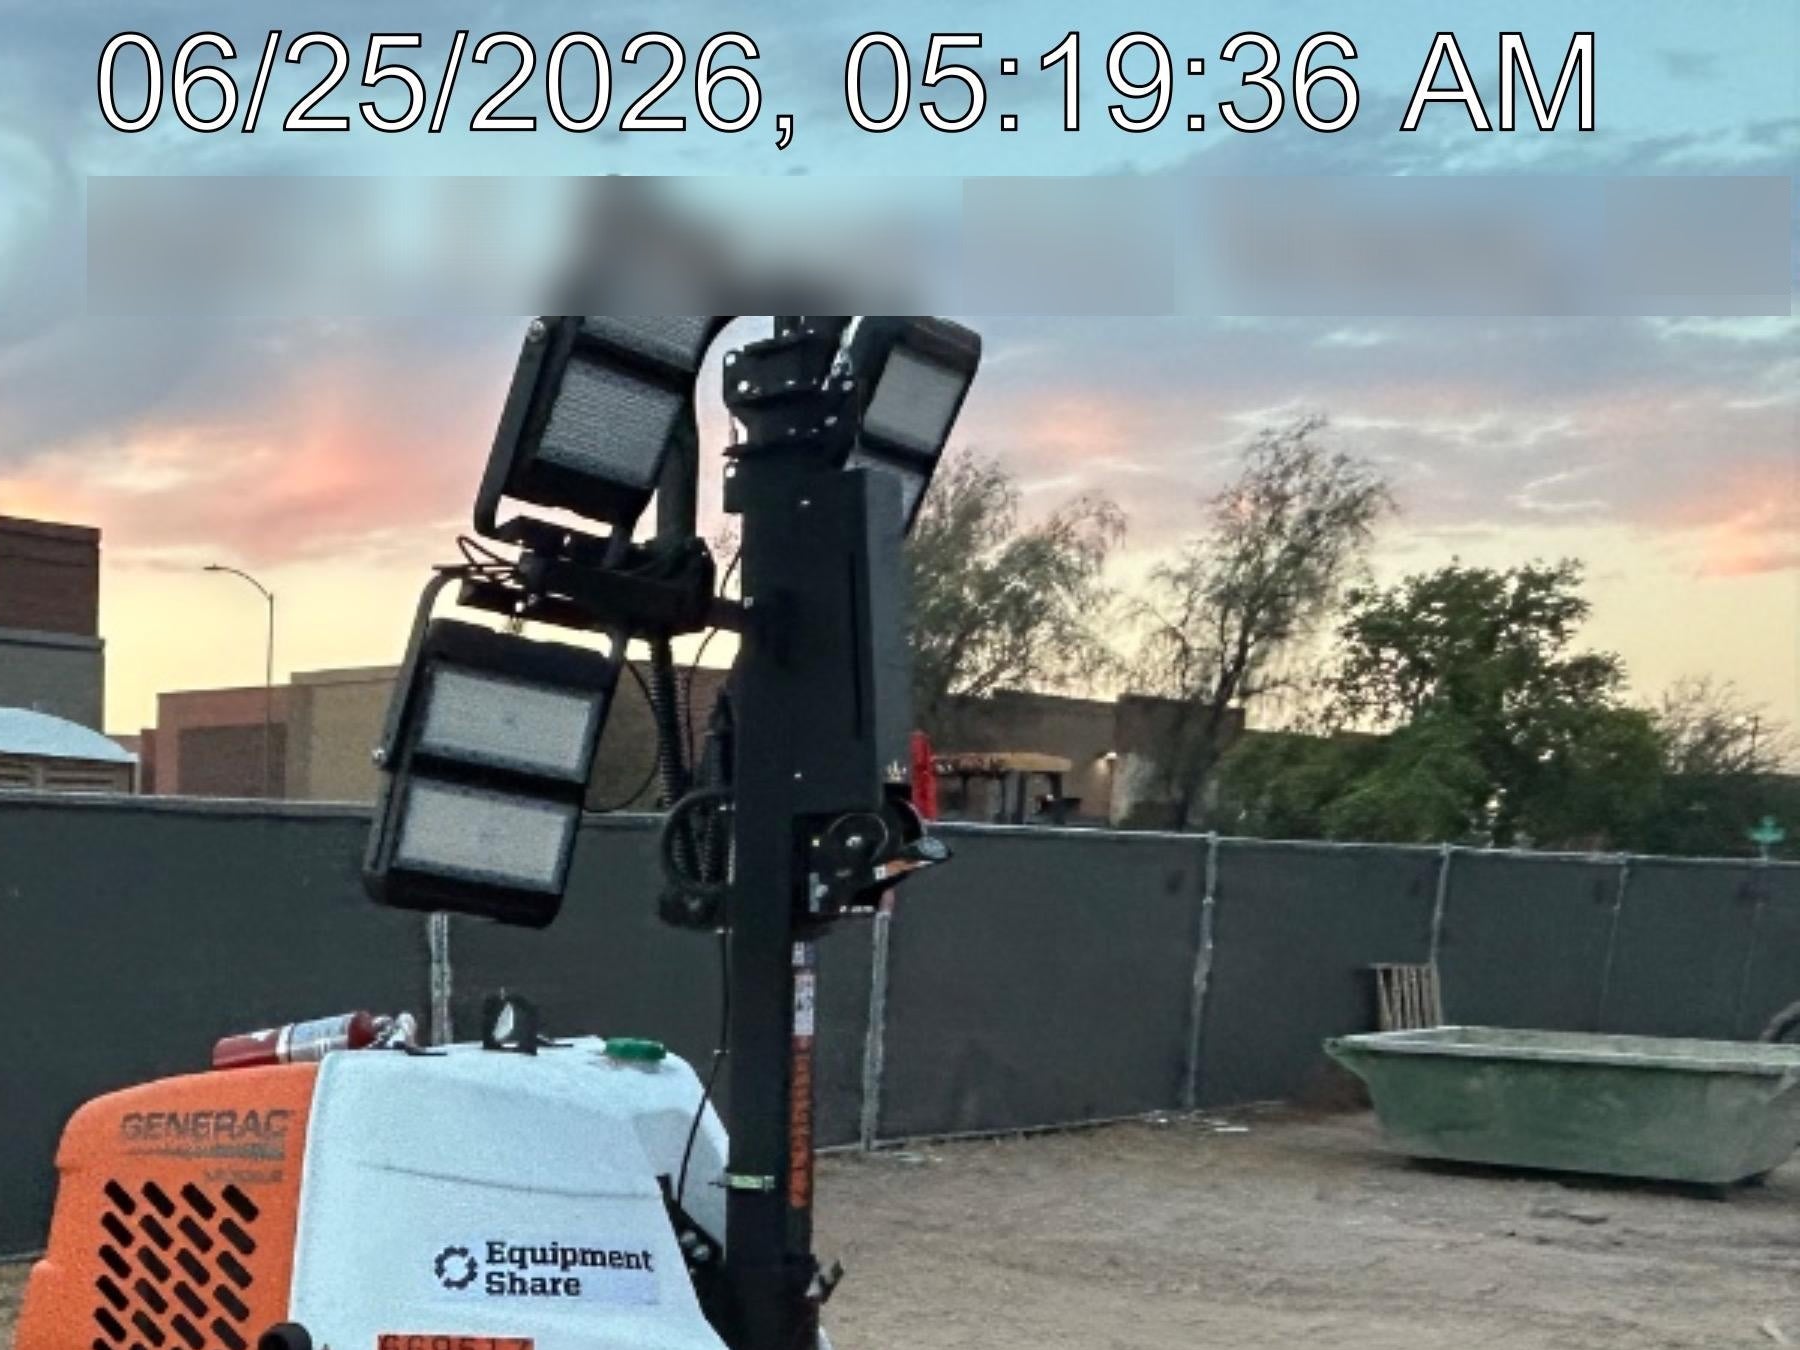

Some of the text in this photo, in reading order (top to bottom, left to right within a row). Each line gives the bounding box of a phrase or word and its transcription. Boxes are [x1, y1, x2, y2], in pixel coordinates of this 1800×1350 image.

[120, 1110, 290, 1142] GENERAC
[485, 1241, 654, 1272] Equipment
[485, 1271, 581, 1296] Share
